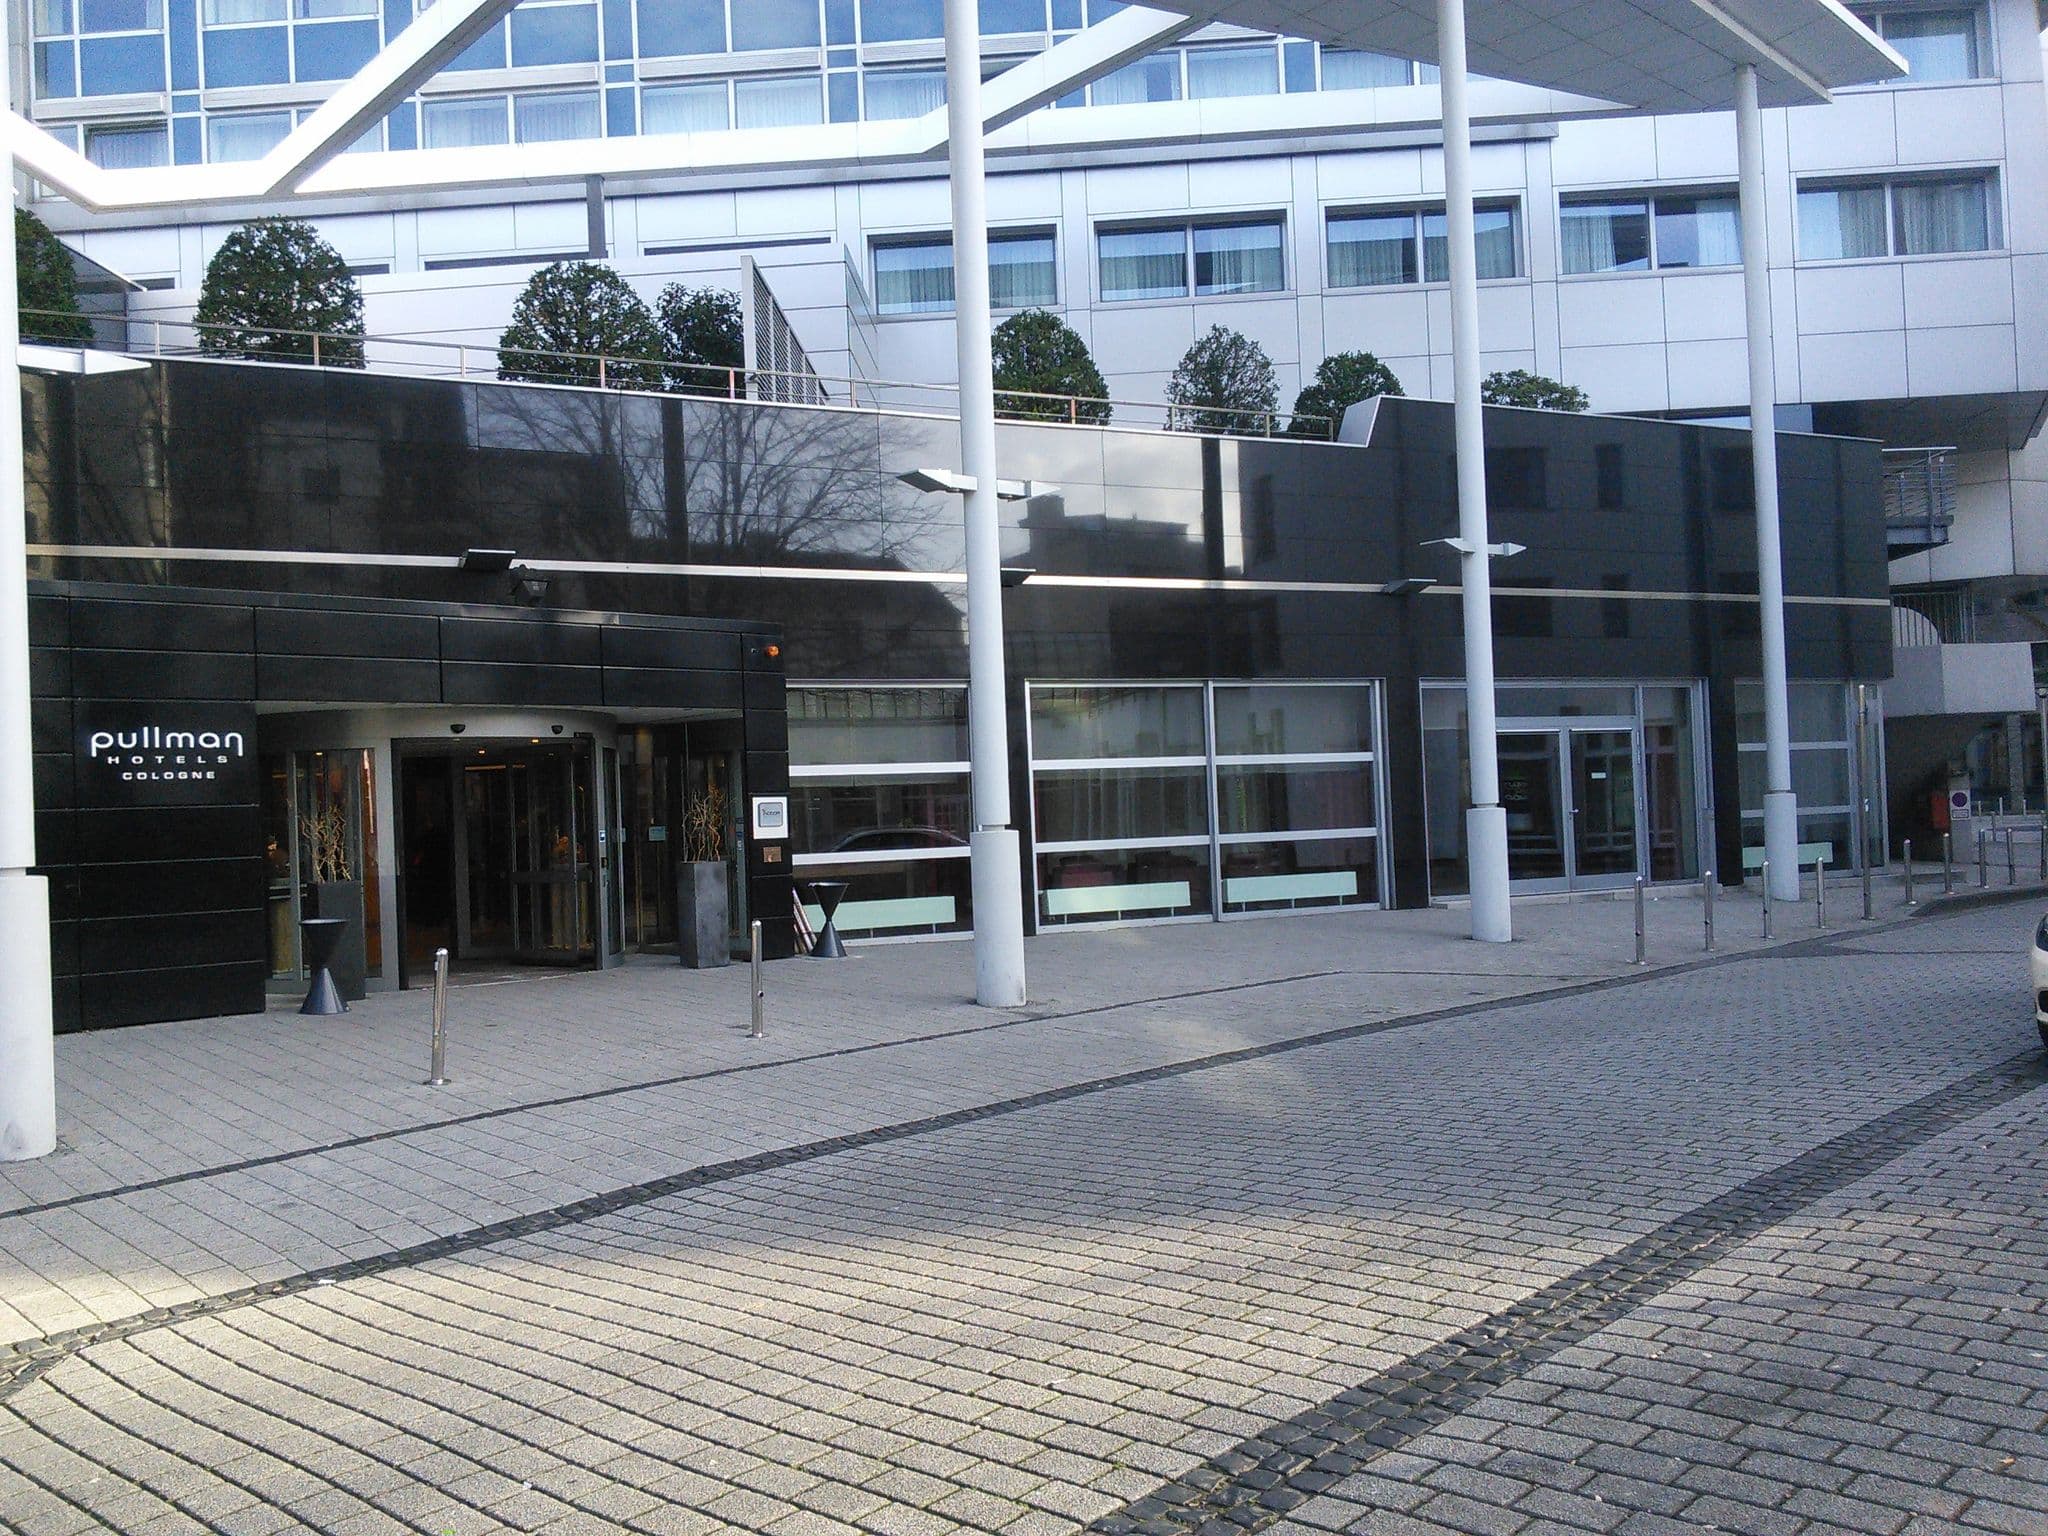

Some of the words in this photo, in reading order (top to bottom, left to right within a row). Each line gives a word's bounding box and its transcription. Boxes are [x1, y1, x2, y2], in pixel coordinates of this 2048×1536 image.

[91, 726, 243, 757] pullman
[107, 756, 228, 764] HOTELS
[122, 771, 216, 780] COLOGNE
